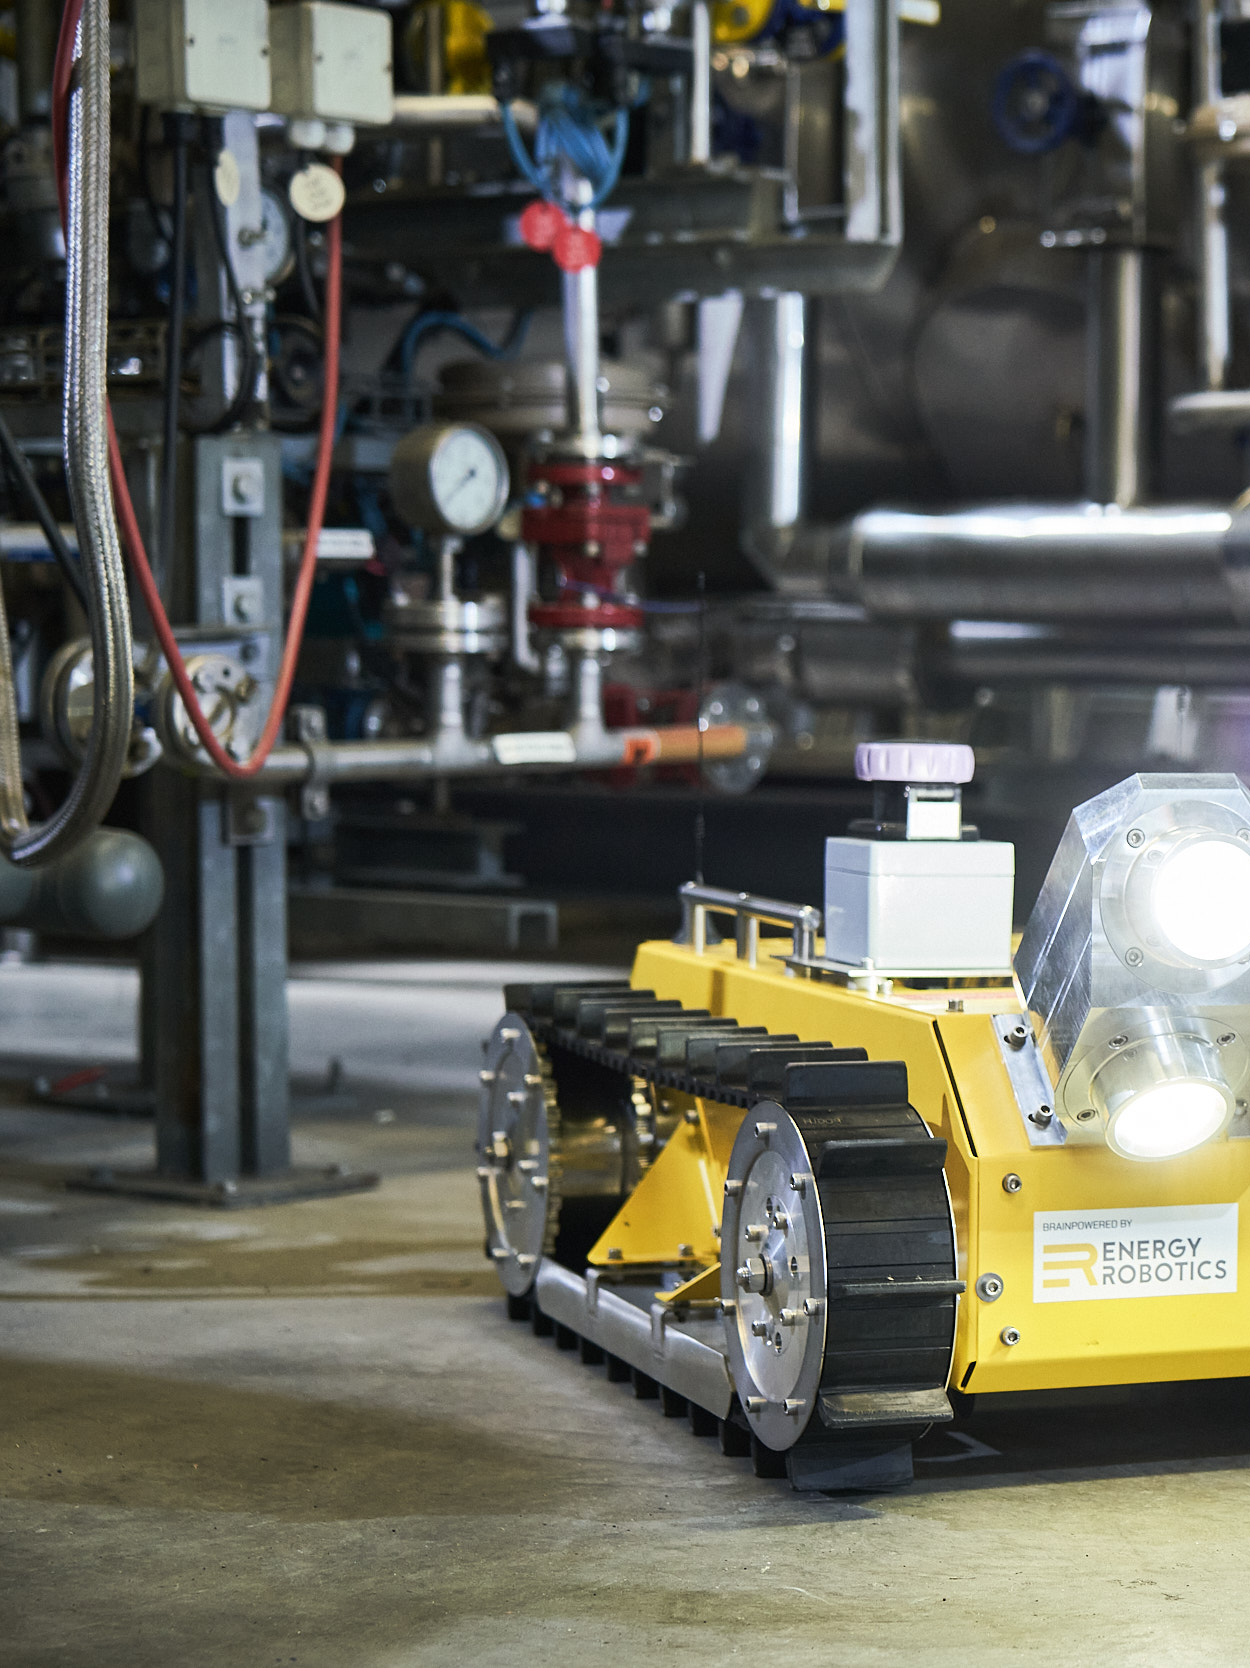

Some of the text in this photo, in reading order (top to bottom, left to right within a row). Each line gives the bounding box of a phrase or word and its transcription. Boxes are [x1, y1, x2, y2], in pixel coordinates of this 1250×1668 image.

[1042, 1219, 1132, 1232] BRAINPOWERED BY
[1103, 1237, 1202, 1262] ENERGY
[1102, 1260, 1227, 1285] ROBOTICS
